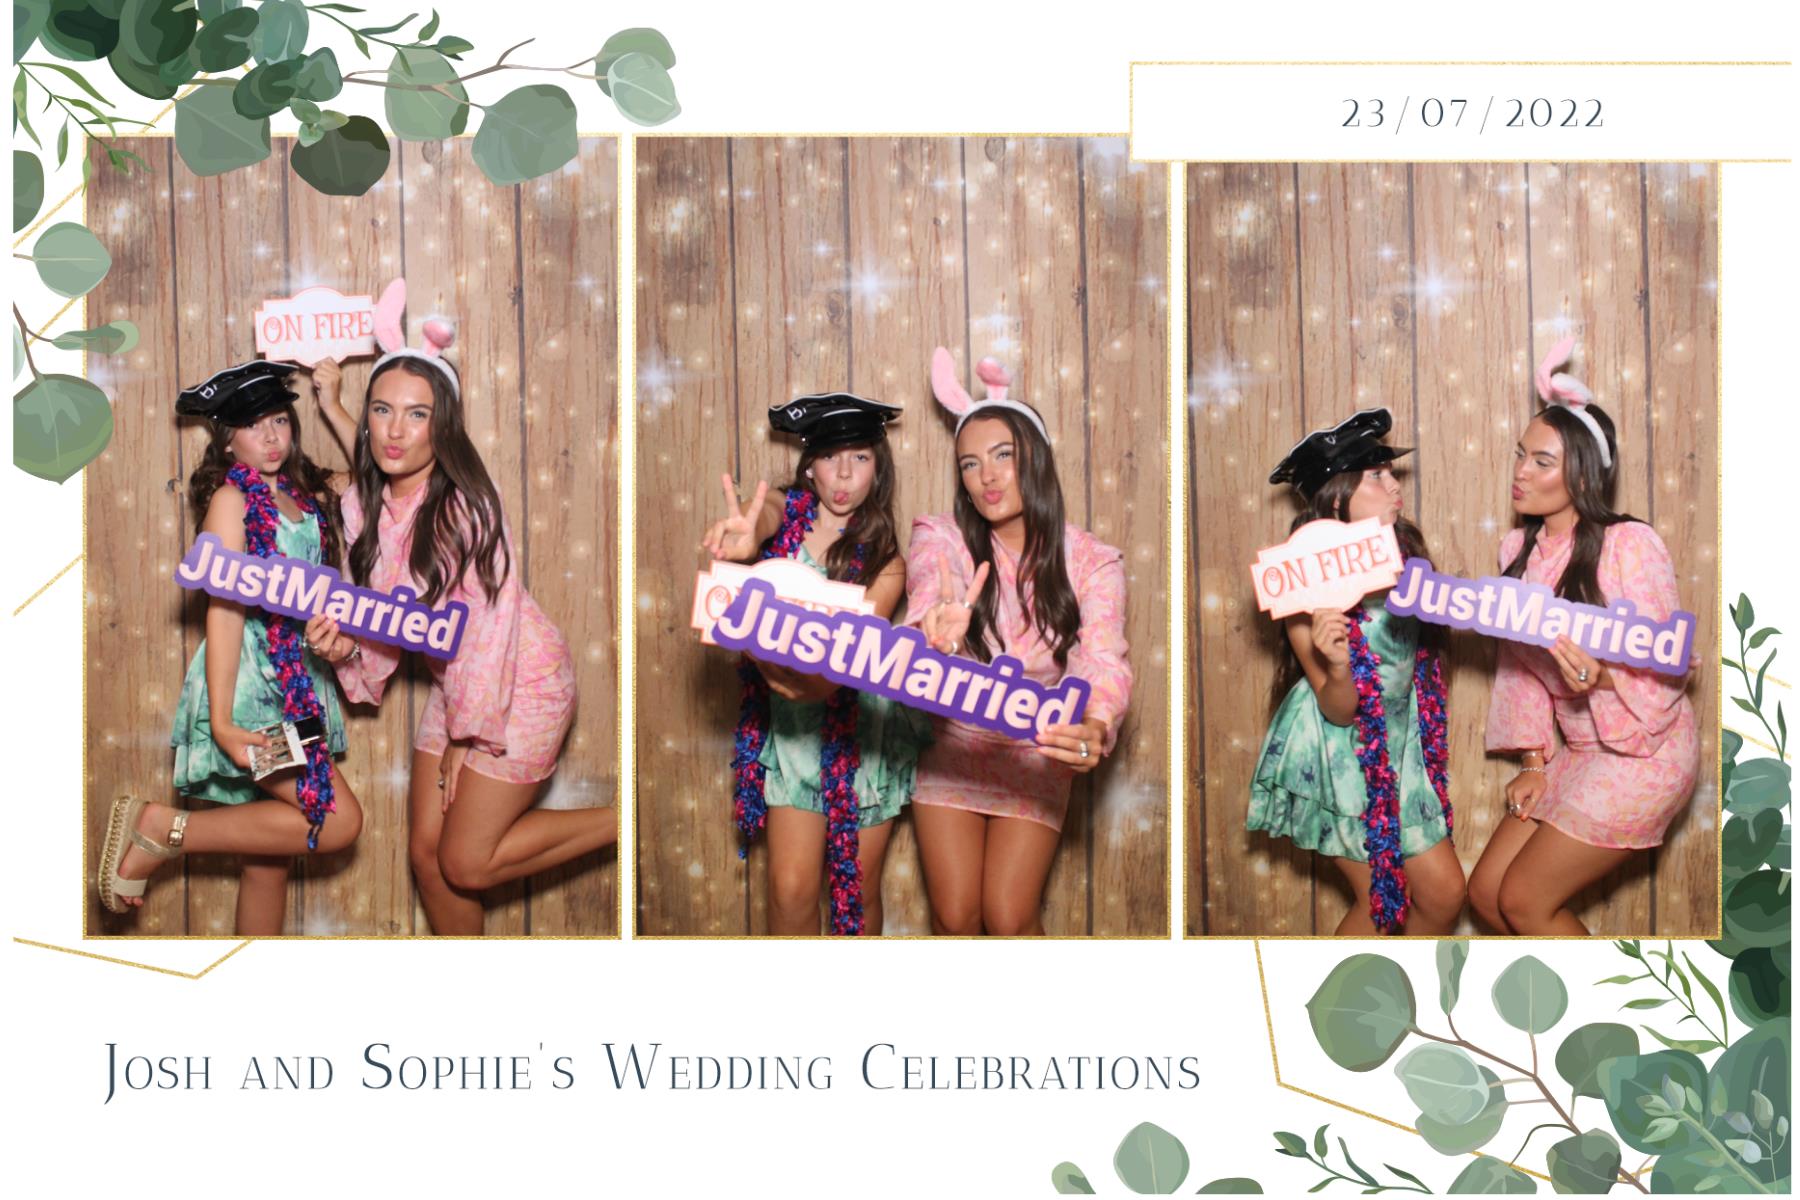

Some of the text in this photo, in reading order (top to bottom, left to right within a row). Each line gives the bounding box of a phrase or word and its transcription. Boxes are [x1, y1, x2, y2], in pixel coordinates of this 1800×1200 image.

[262, 310, 376, 345] ON FIRE
[1262, 534, 1392, 598] ON FIRE
